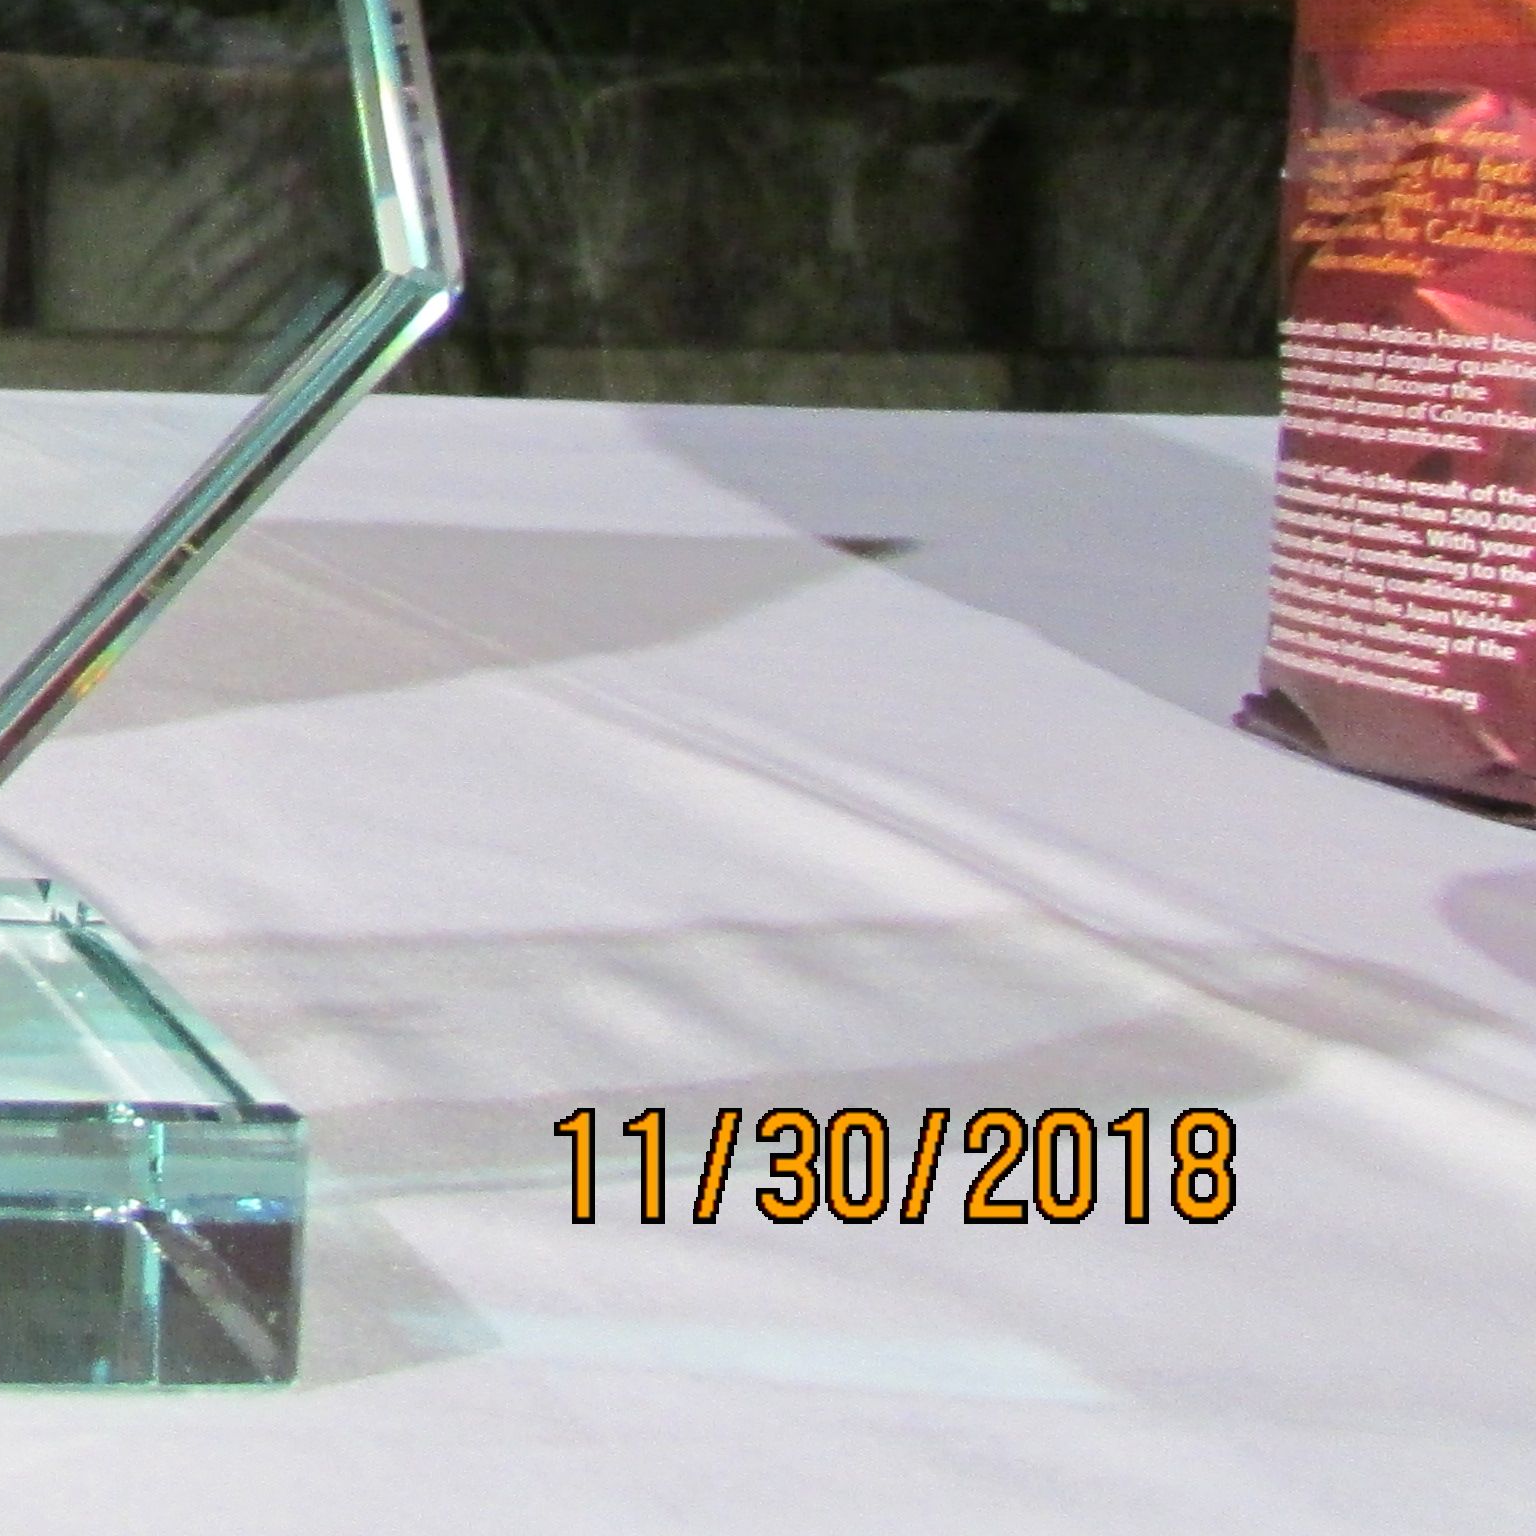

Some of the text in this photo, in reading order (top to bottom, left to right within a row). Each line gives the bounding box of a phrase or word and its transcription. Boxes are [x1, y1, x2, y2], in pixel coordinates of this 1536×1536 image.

[1437, 328, 1488, 351] have
[1492, 332, 1536, 356] bee
[1450, 379, 1490, 401] the
[1407, 480, 1468, 501] result
[1468, 484, 1497, 503] of
[1426, 528, 1477, 552] With
[1478, 538, 1535, 559] your
[1471, 562, 1497, 580] to
[1450, 633, 1477, 654] of
[1477, 638, 1518, 661] the
